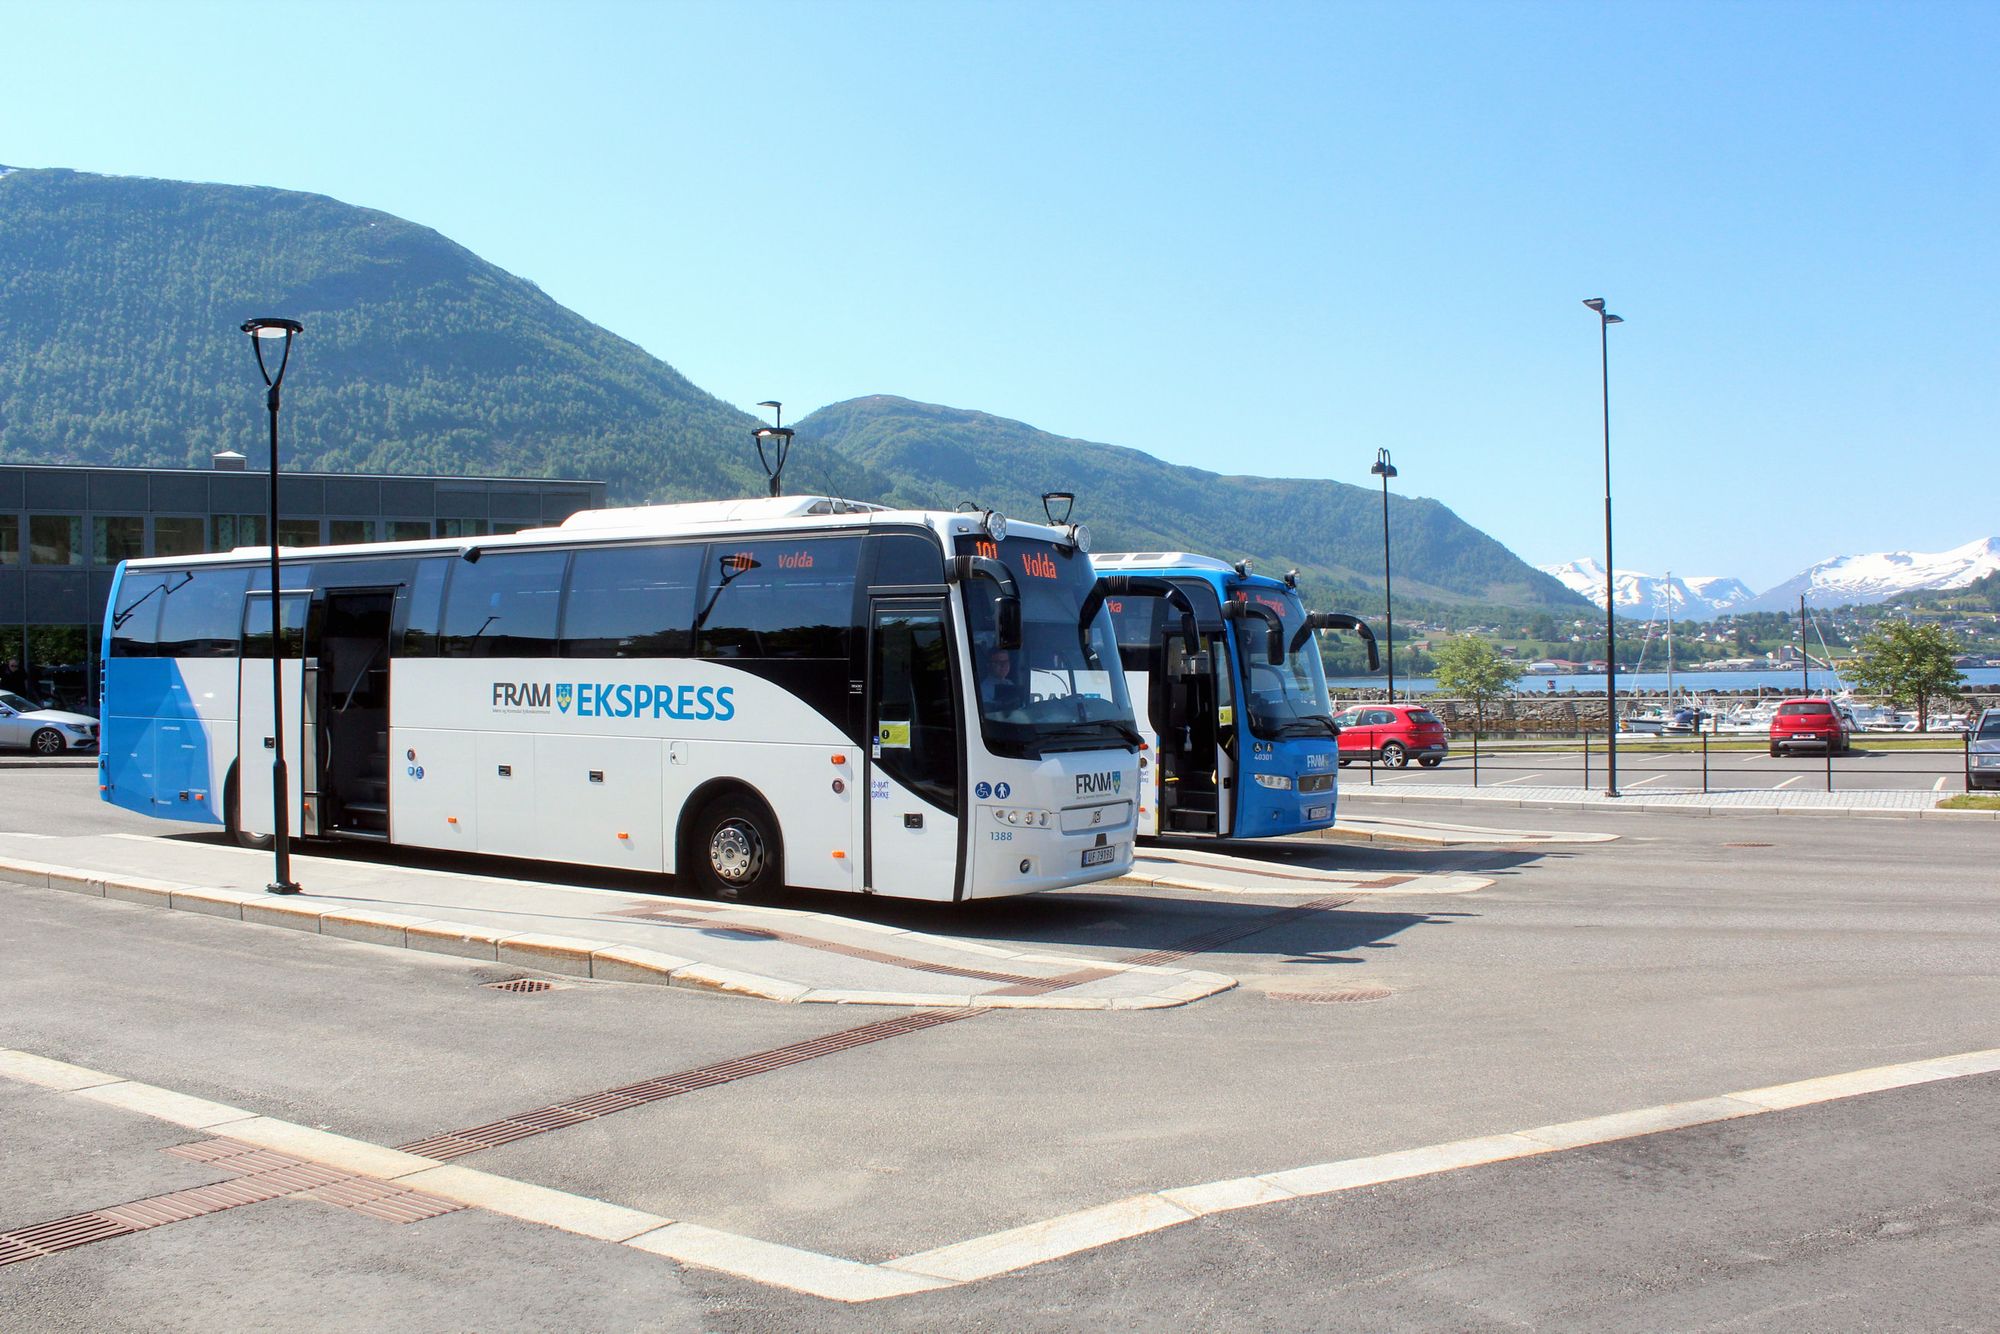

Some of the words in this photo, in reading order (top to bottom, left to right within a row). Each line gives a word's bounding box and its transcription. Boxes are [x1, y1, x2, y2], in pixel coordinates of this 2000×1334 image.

[778, 551, 814, 568] Volda
[975, 541, 998, 560] 101
[1021, 552, 1057, 579] Volda
[492, 682, 551, 707] FRAM
[577, 683, 735, 721] EKSPRESS
[1254, 753, 1273, 761] 40301
[1307, 754, 1325, 768] FRAM
[1076, 771, 1112, 794] FRAM
[990, 831, 1012, 841] 1388
